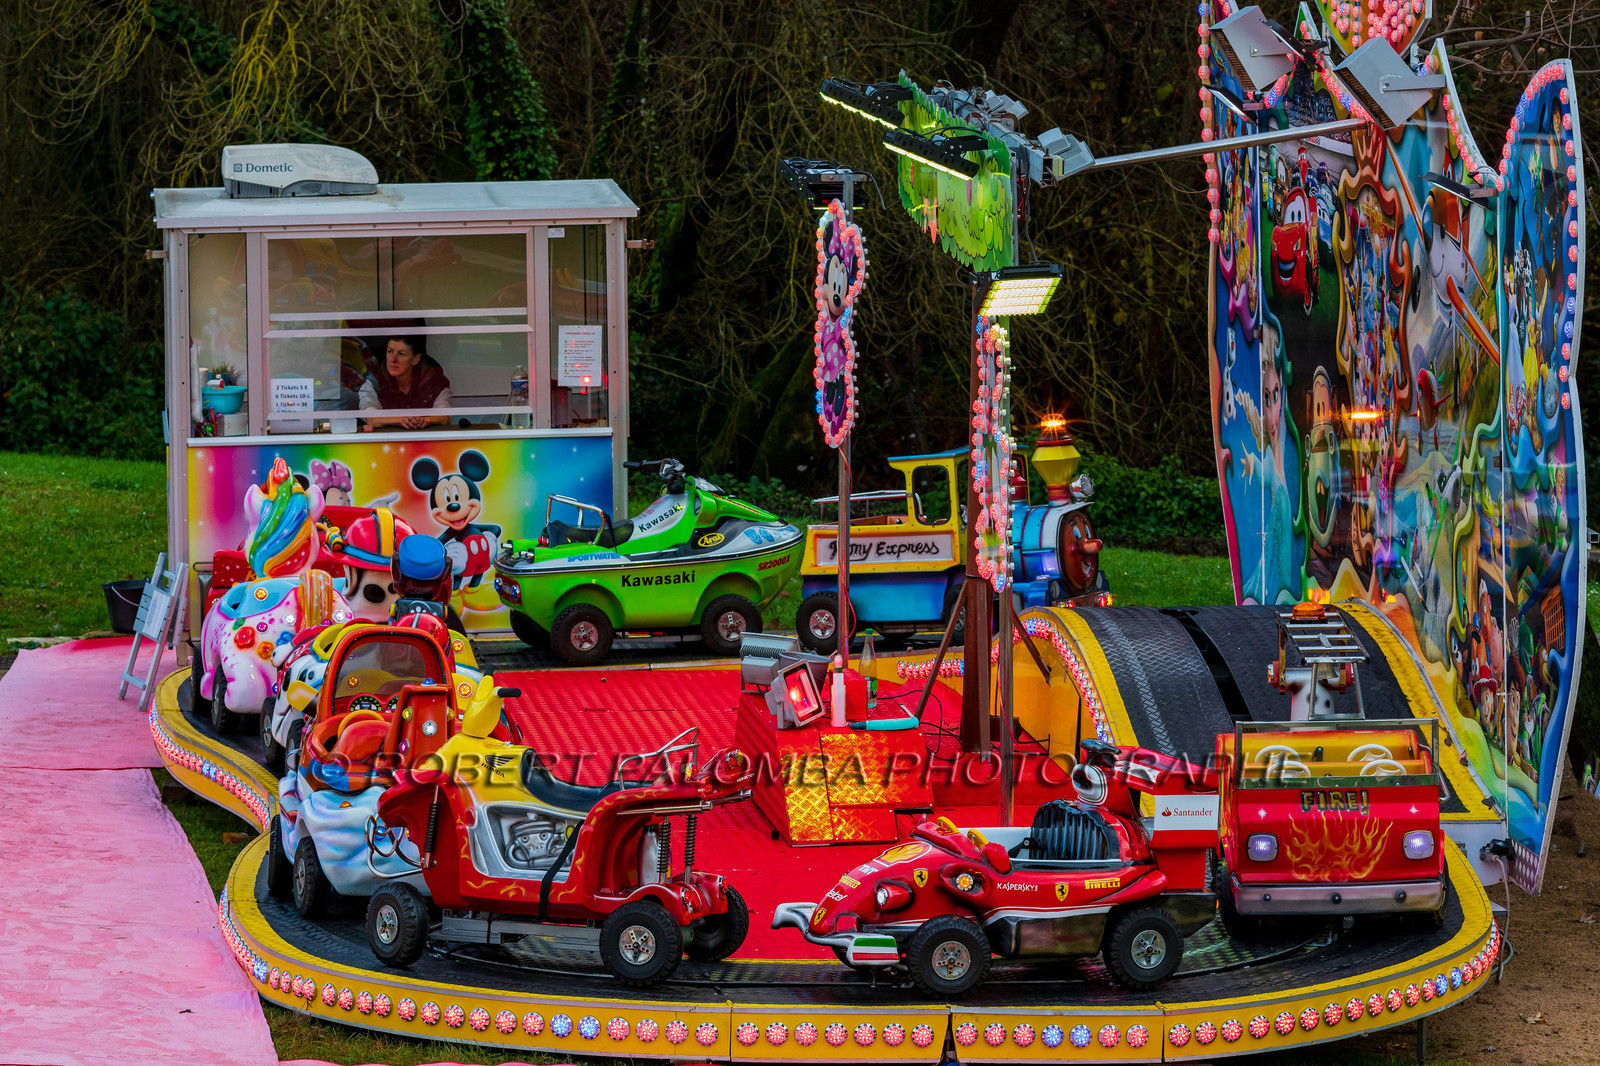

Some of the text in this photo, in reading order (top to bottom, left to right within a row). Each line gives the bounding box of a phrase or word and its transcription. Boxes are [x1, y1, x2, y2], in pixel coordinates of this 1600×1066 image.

[245, 163, 294, 173] Dometic
[638, 503, 684, 533] Kawasaki
[876, 541, 940, 559] Express
[567, 552, 621, 563] SPORTWATER
[621, 571, 696, 588] Kawasaki
[481, 762, 505, 778] HONDA
[1300, 790, 1369, 816] FIRE!
[1173, 807, 1214, 817] Santander
[996, 882, 1035, 892] KASPERSKY
[1084, 878, 1121, 890] PIRELLI
